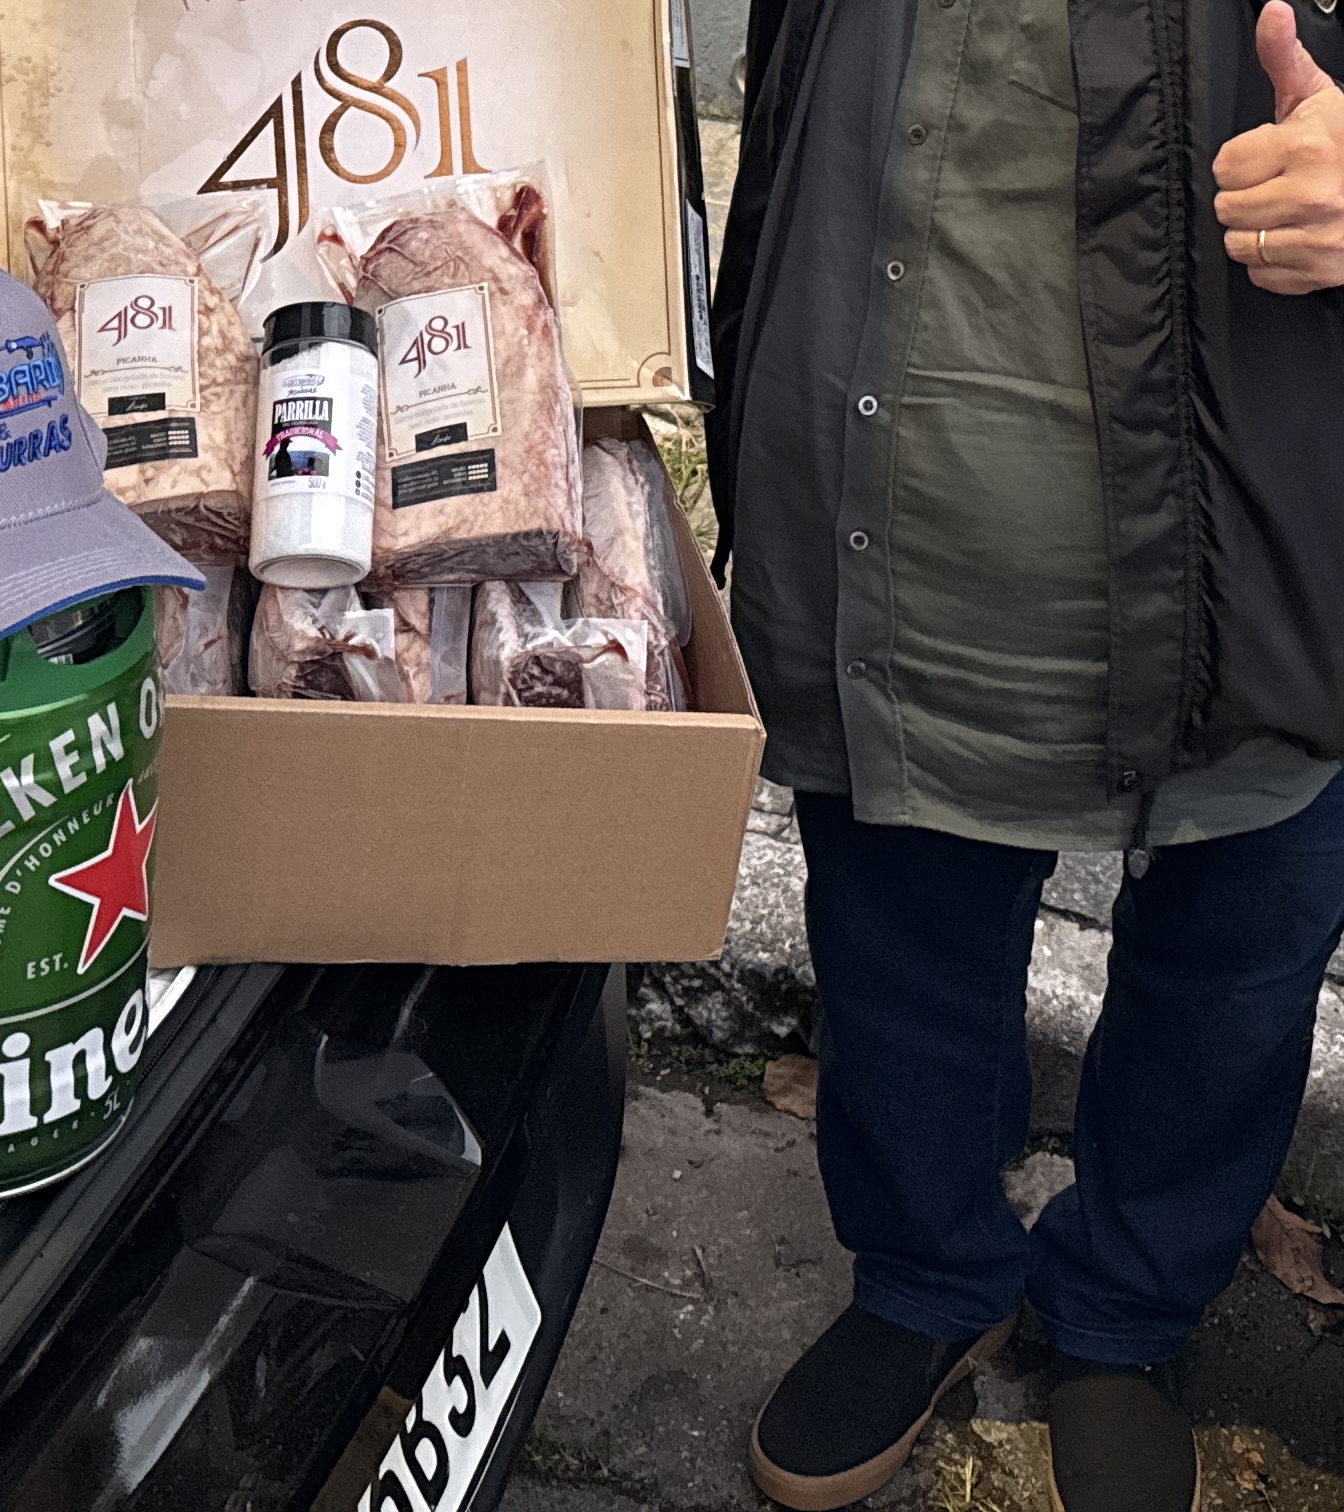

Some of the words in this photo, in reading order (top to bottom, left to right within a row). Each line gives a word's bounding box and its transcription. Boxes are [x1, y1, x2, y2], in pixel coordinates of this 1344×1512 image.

[196, 19, 493, 262] 481
[97, 294, 176, 347] 481
[398, 315, 472, 378] 481
[116, 355, 158, 365] PICANHA
[274, 399, 330, 425] PARRILLA
[418, 382, 457, 398] PICANHA
[138, 675, 160, 740] O
[5, 792, 115, 895] D'HONNEUR
[26, 952, 69, 980] EST.
